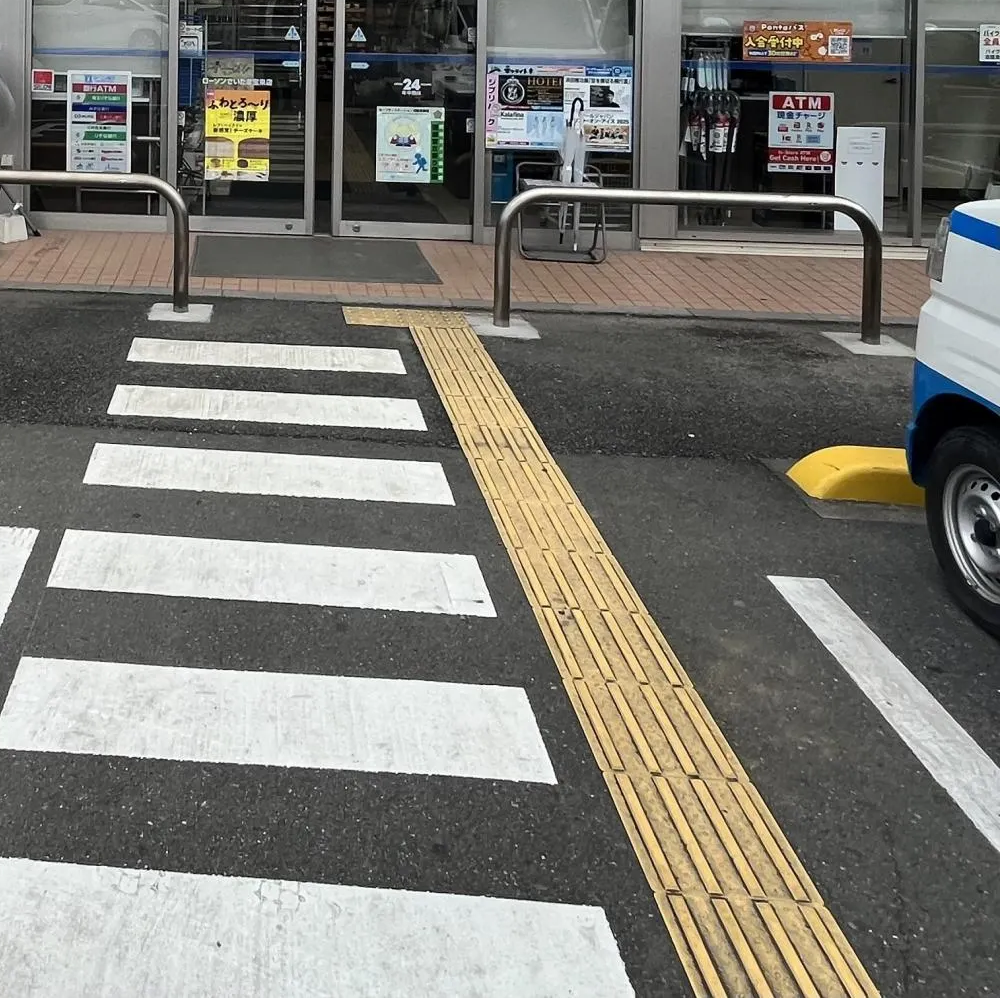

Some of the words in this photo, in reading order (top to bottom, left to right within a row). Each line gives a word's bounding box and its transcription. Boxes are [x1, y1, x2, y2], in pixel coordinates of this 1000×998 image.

[744, 35, 804, 48] 入会受付中
[402, 78, 421, 91] 24
[208, 97, 268, 110] ふわとろ〜り
[487, 78, 496, 126] ジブリク
[782, 96, 822, 110] ATM
[233, 110, 257, 122] 濃厚
[777, 111, 826, 120] 現金チャージ
